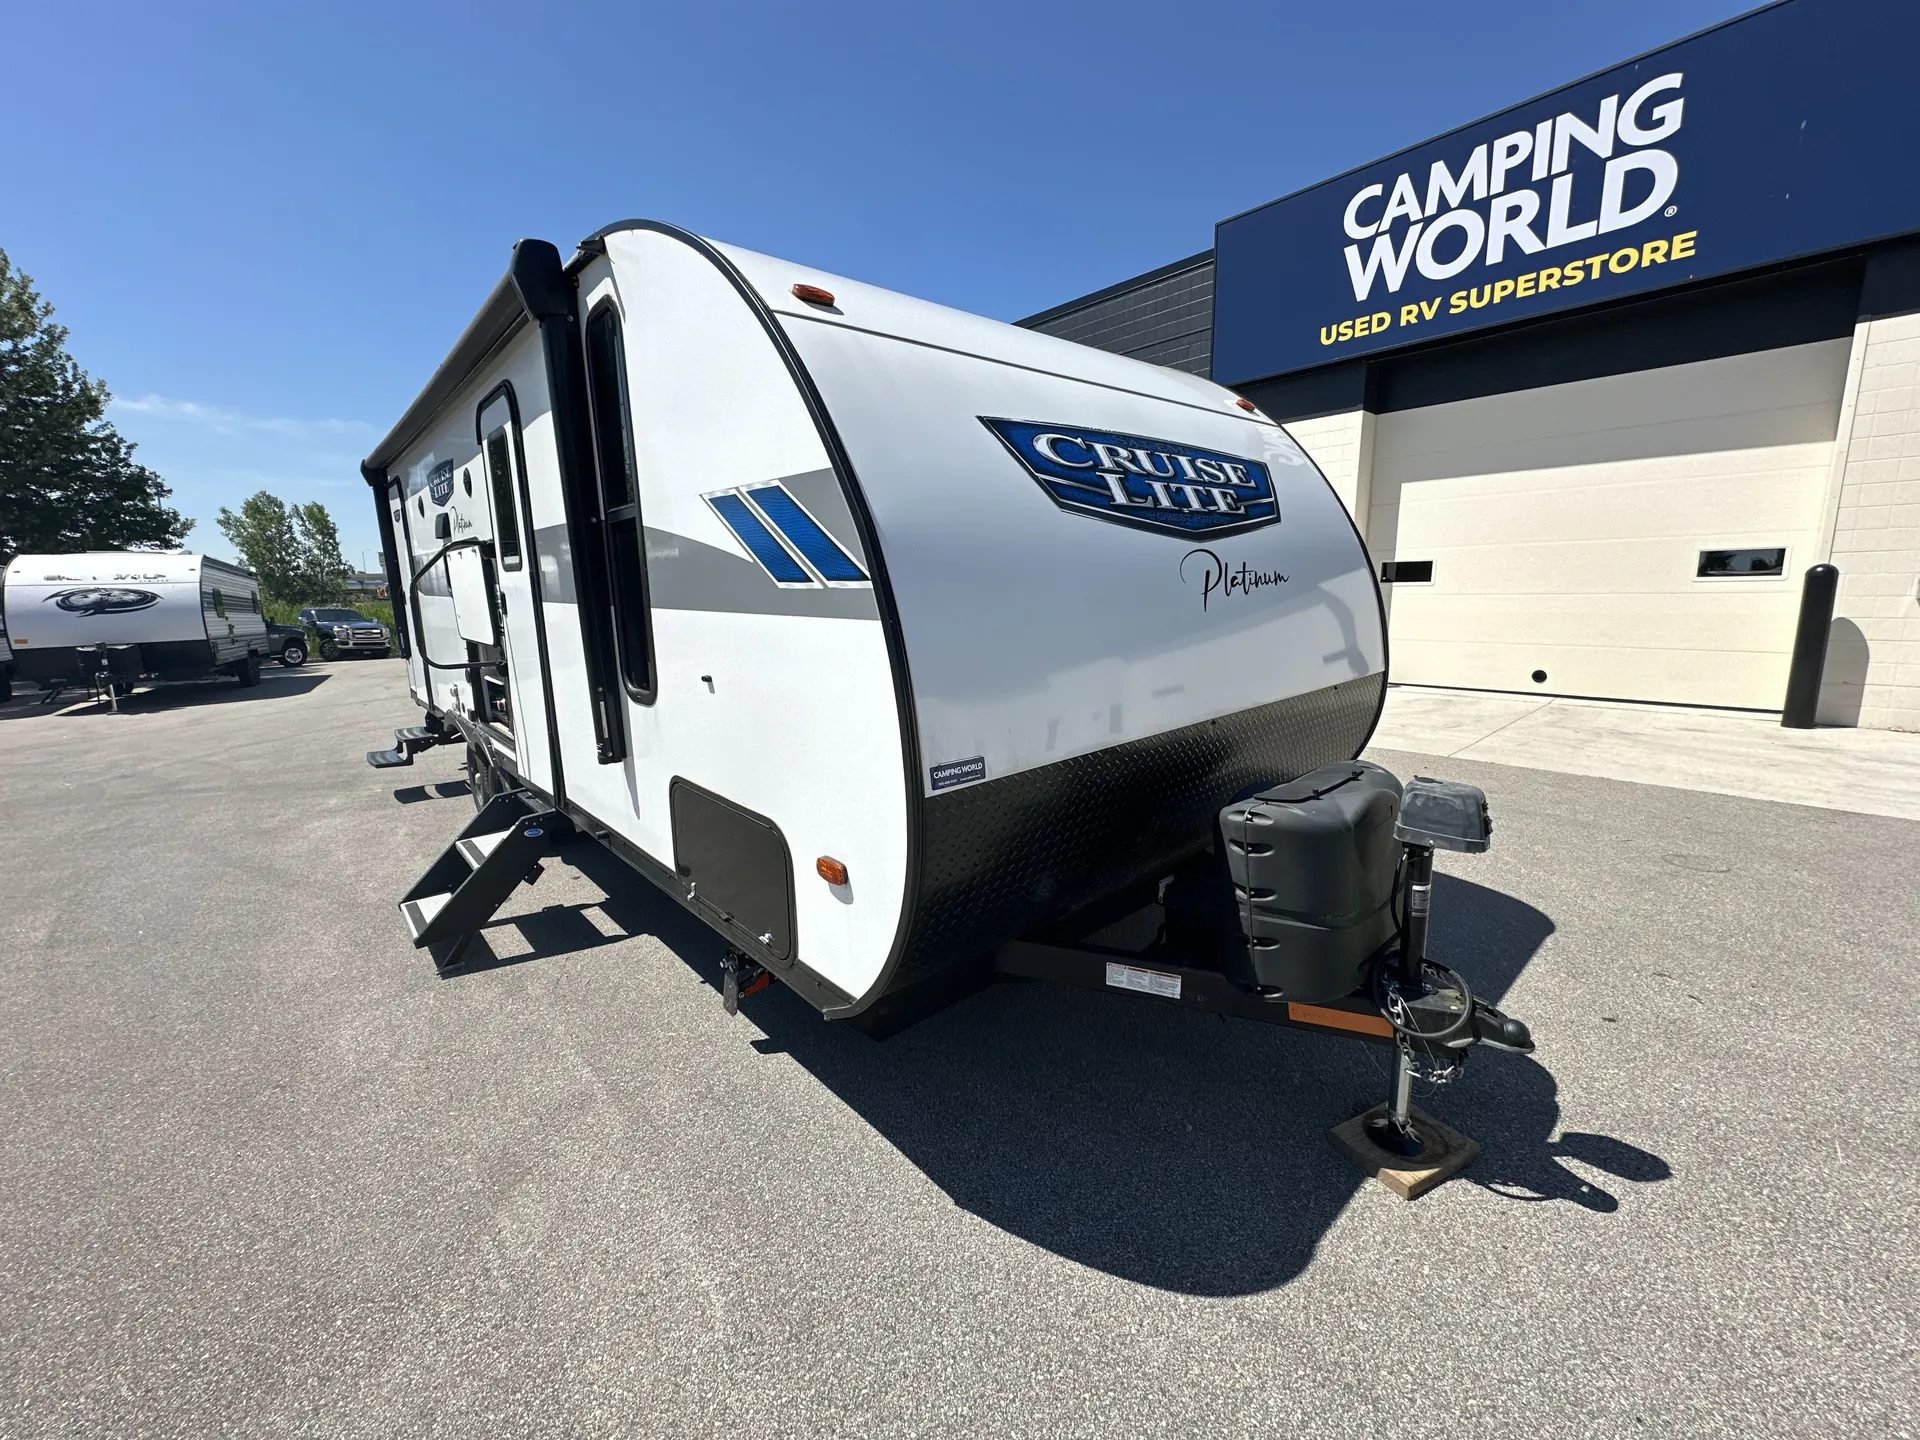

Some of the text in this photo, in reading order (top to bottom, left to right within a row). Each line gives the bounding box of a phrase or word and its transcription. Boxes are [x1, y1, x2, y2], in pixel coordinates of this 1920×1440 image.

[1343, 72, 1685, 241] CAMPING
[1343, 149, 1679, 302] WORLD
[1320, 230, 1698, 346] USED RV SUPERSTORE
[433, 481, 450, 499] LITE
[1032, 432, 1257, 488] CRUISE
[1096, 471, 1246, 515] LITE
[1180, 548, 1290, 612] Platinum
[933, 767, 962, 779] CAMPING
[961, 762, 983, 773] WORLD
